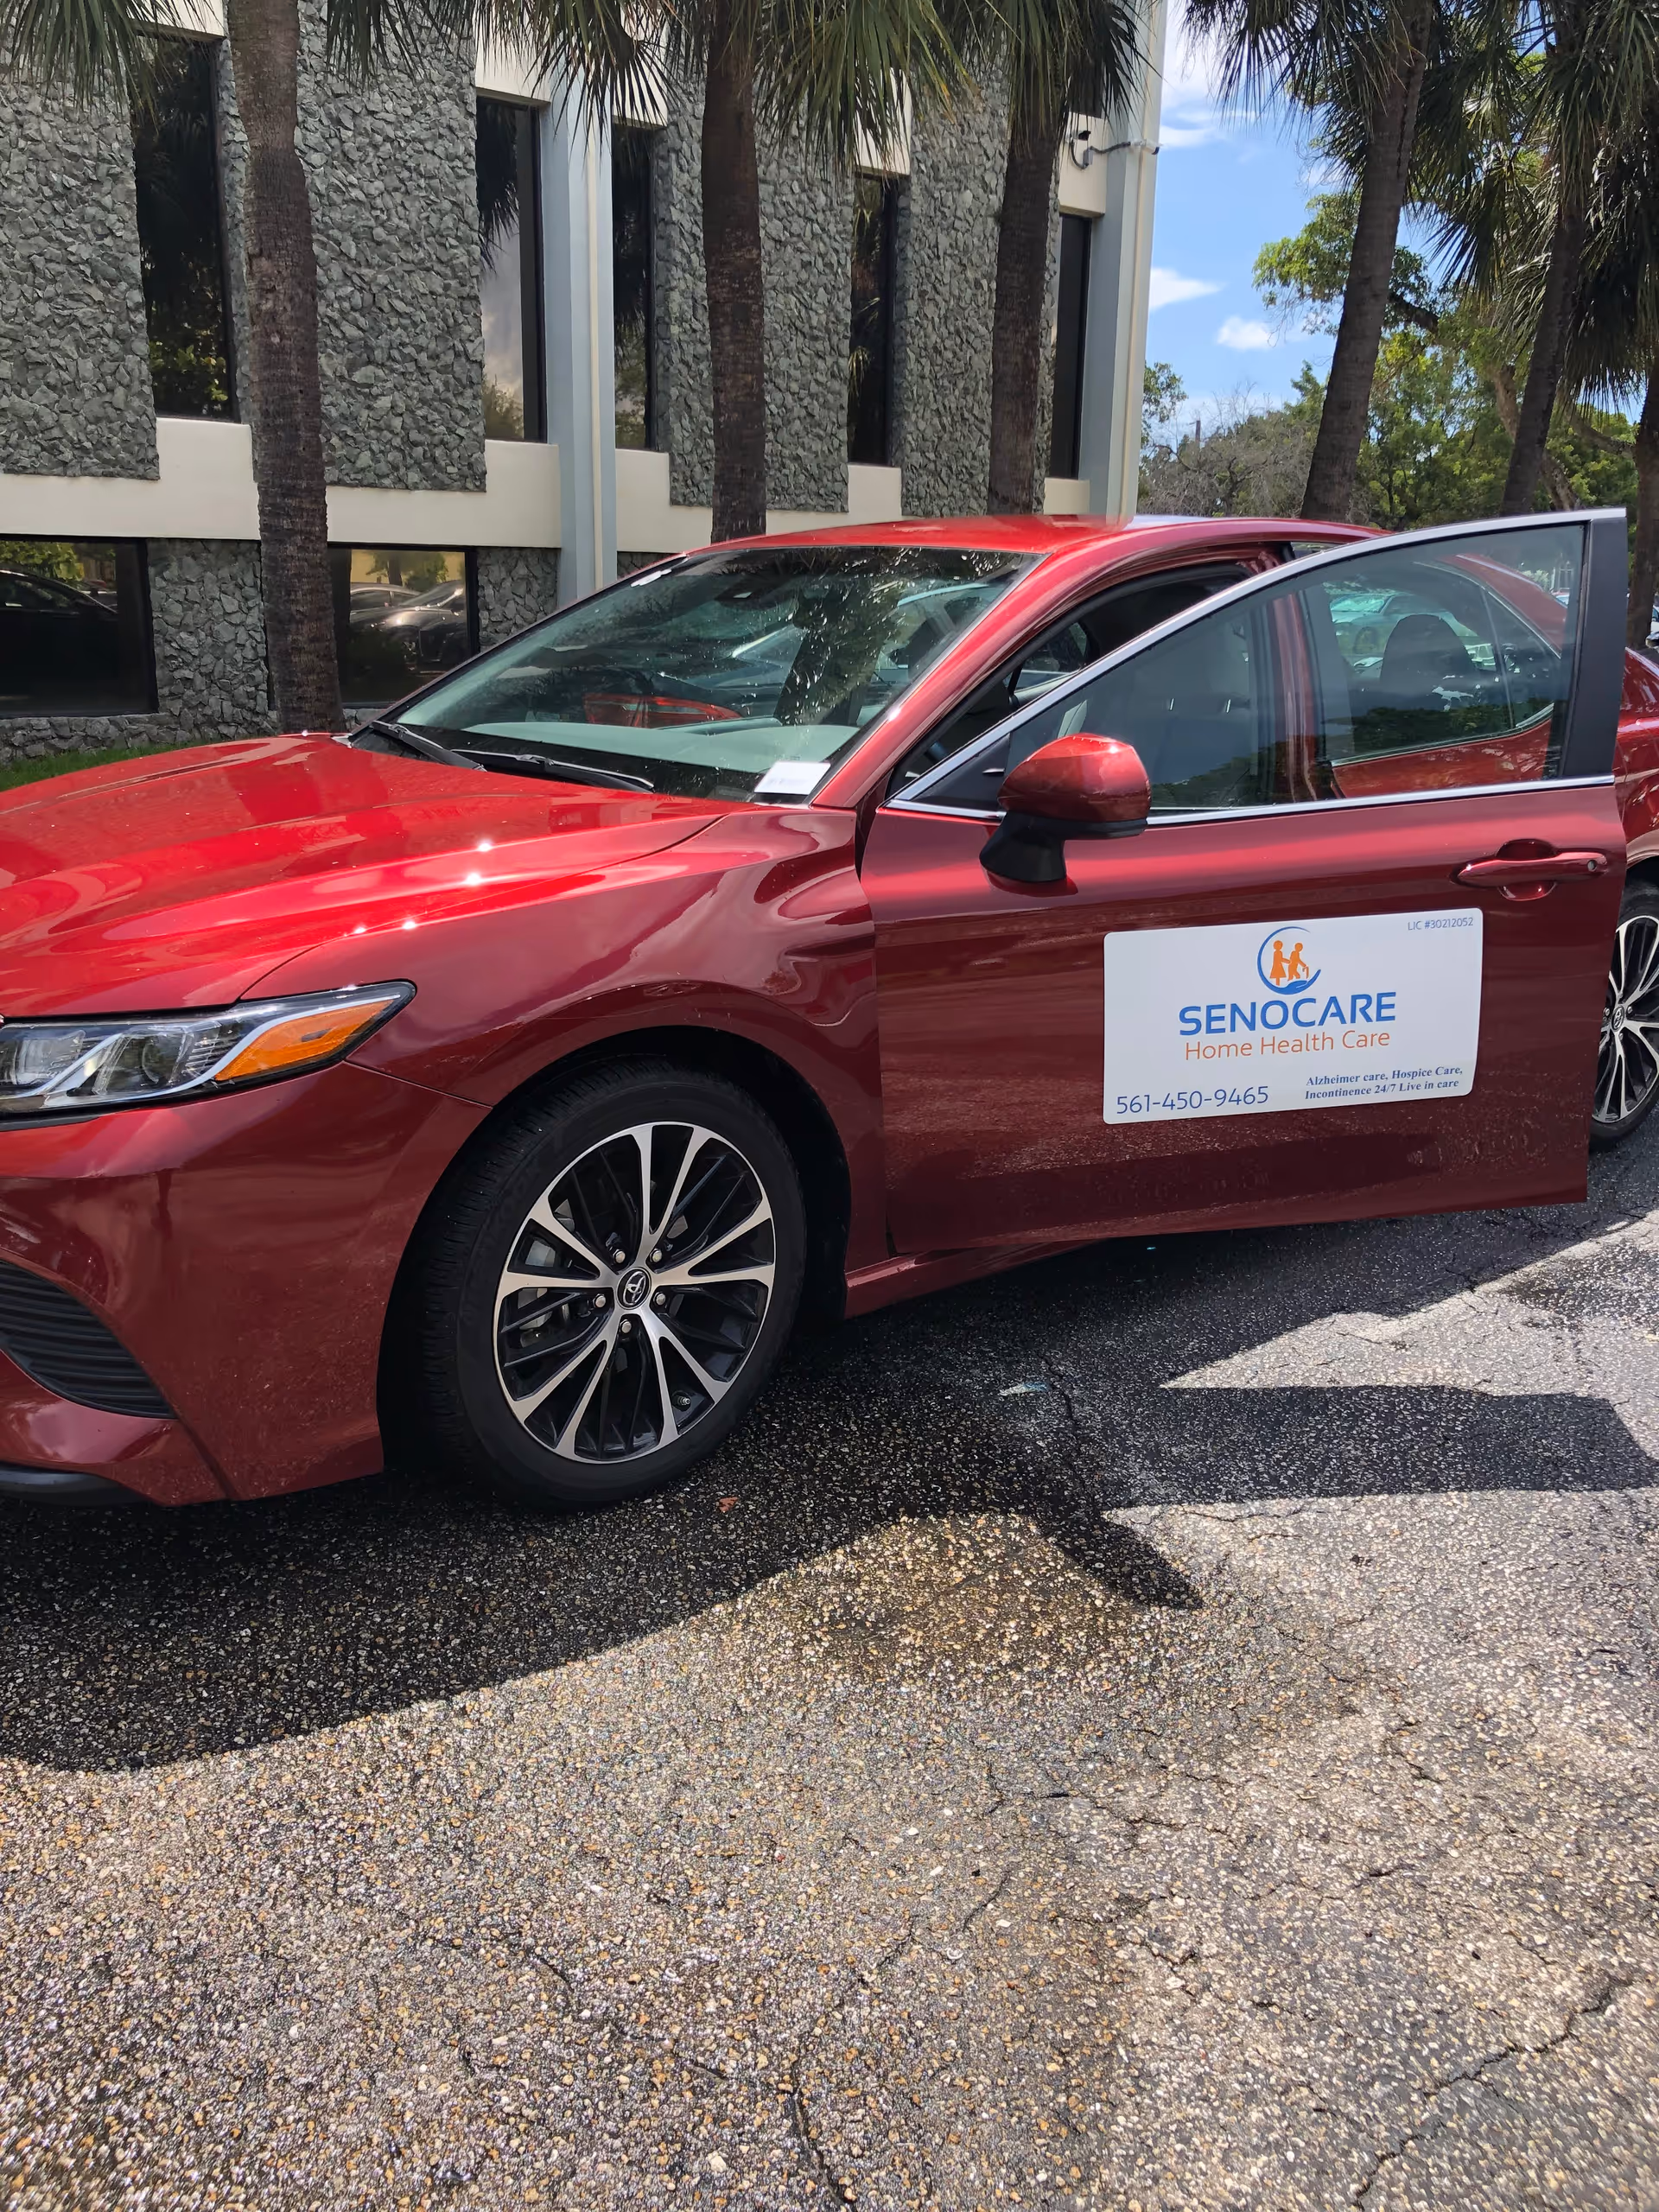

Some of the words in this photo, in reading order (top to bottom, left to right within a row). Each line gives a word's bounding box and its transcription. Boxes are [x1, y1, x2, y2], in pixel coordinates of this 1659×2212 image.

[1408, 920, 1421, 931] LIC
[1425, 917, 1473, 930] #30212052
[1179, 991, 1397, 1036] SENOCARE
[1185, 1041, 1253, 1061] Home
[1261, 1032, 1334, 1055] Health
[1342, 1030, 1390, 1049] Care
[1306, 1074, 1360, 1086] Alzheimer
[1363, 1072, 1389, 1082] care,
[1391, 1069, 1433, 1080] Hospice
[1434, 1065, 1463, 1077] Care,
[1116, 1085, 1268, 1115] 561-450-9465
[1305, 1087, 1372, 1100] Incontinence
[1374, 1083, 1396, 1094] 24/7
[1399, 1081, 1421, 1092] Live
[1424, 1079, 1434, 1090] in
[1437, 1080, 1459, 1089] care
